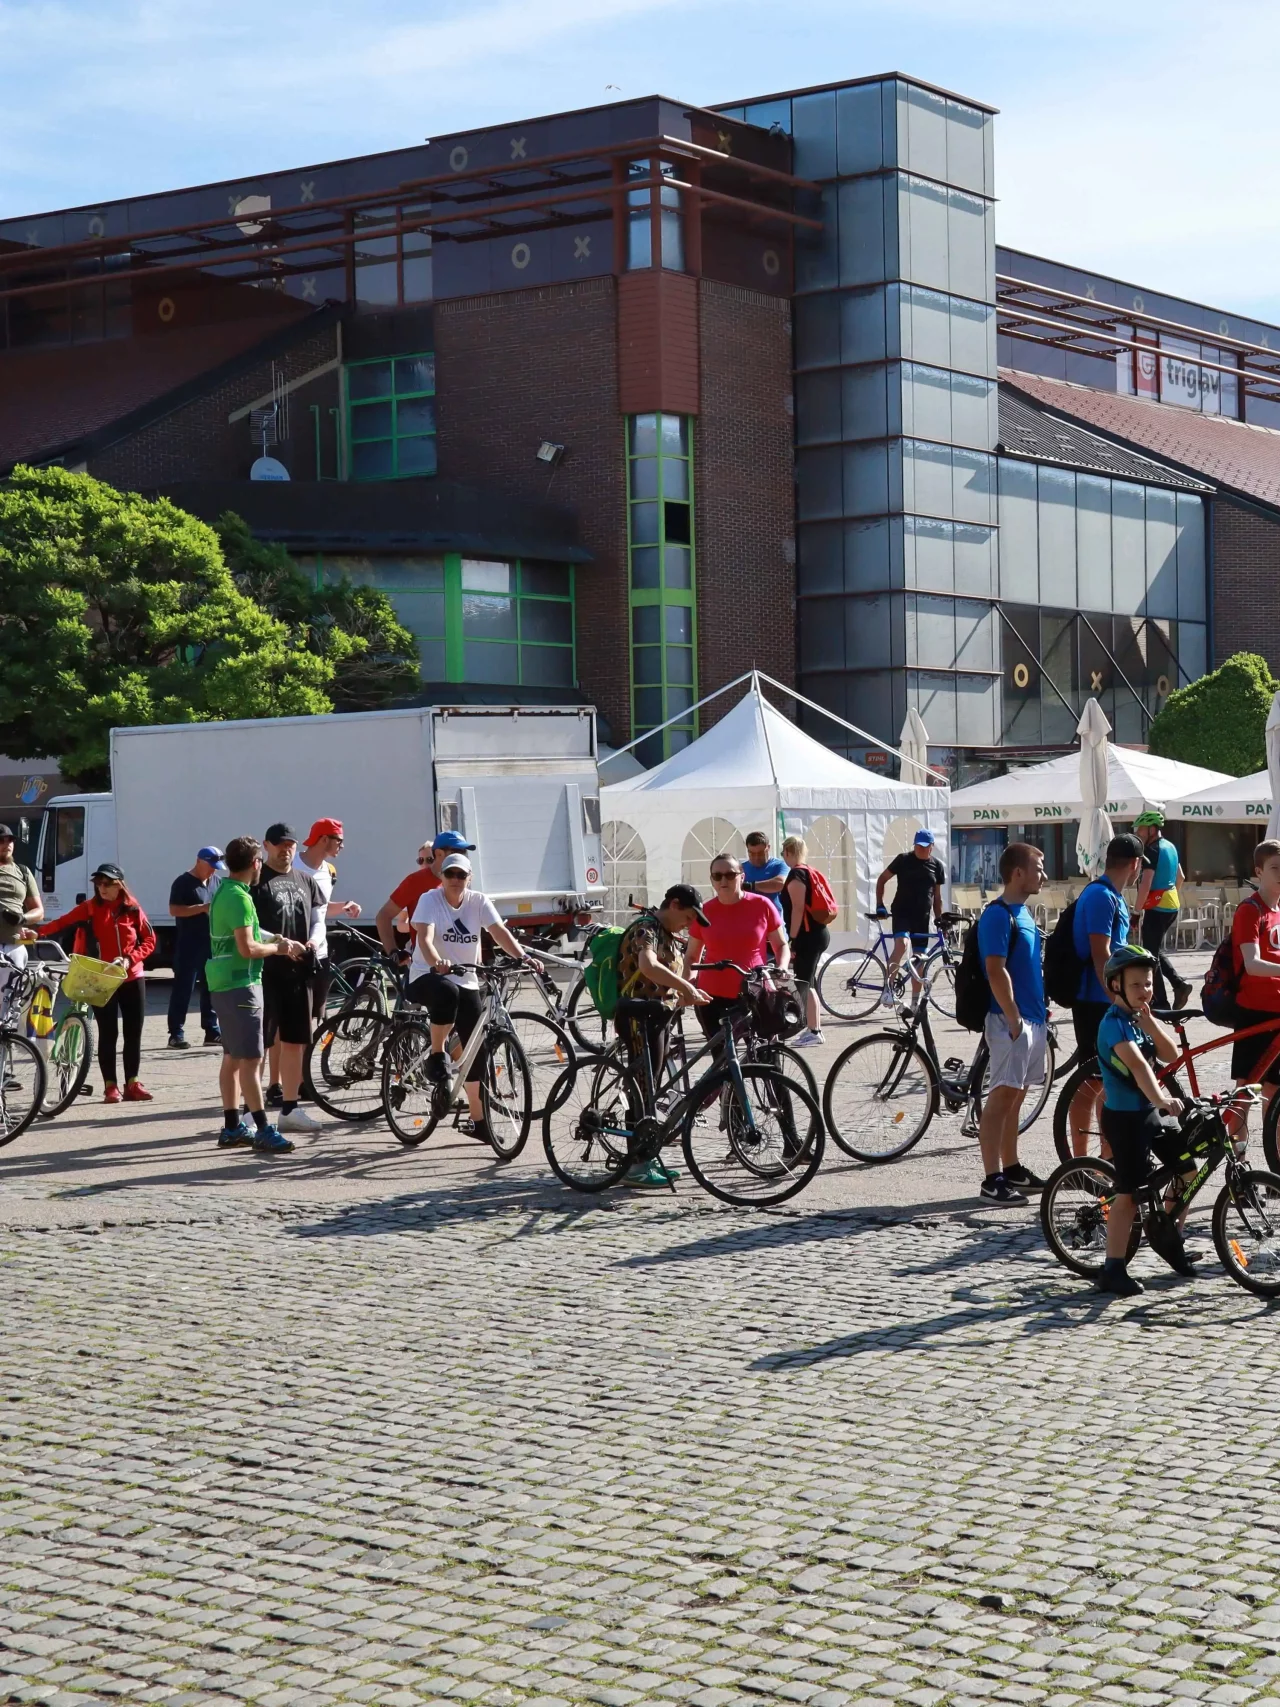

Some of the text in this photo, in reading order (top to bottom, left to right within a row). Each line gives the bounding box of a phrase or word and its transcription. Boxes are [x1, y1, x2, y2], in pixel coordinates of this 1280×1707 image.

[1166, 358, 1219, 398] triglav
[973, 809, 1000, 820] PAN
[1034, 806, 1062, 817] PAN
[1182, 805, 1213, 816] PAN
[442, 933, 478, 944] adidas
[1183, 1163, 1209, 1203] SPRING
